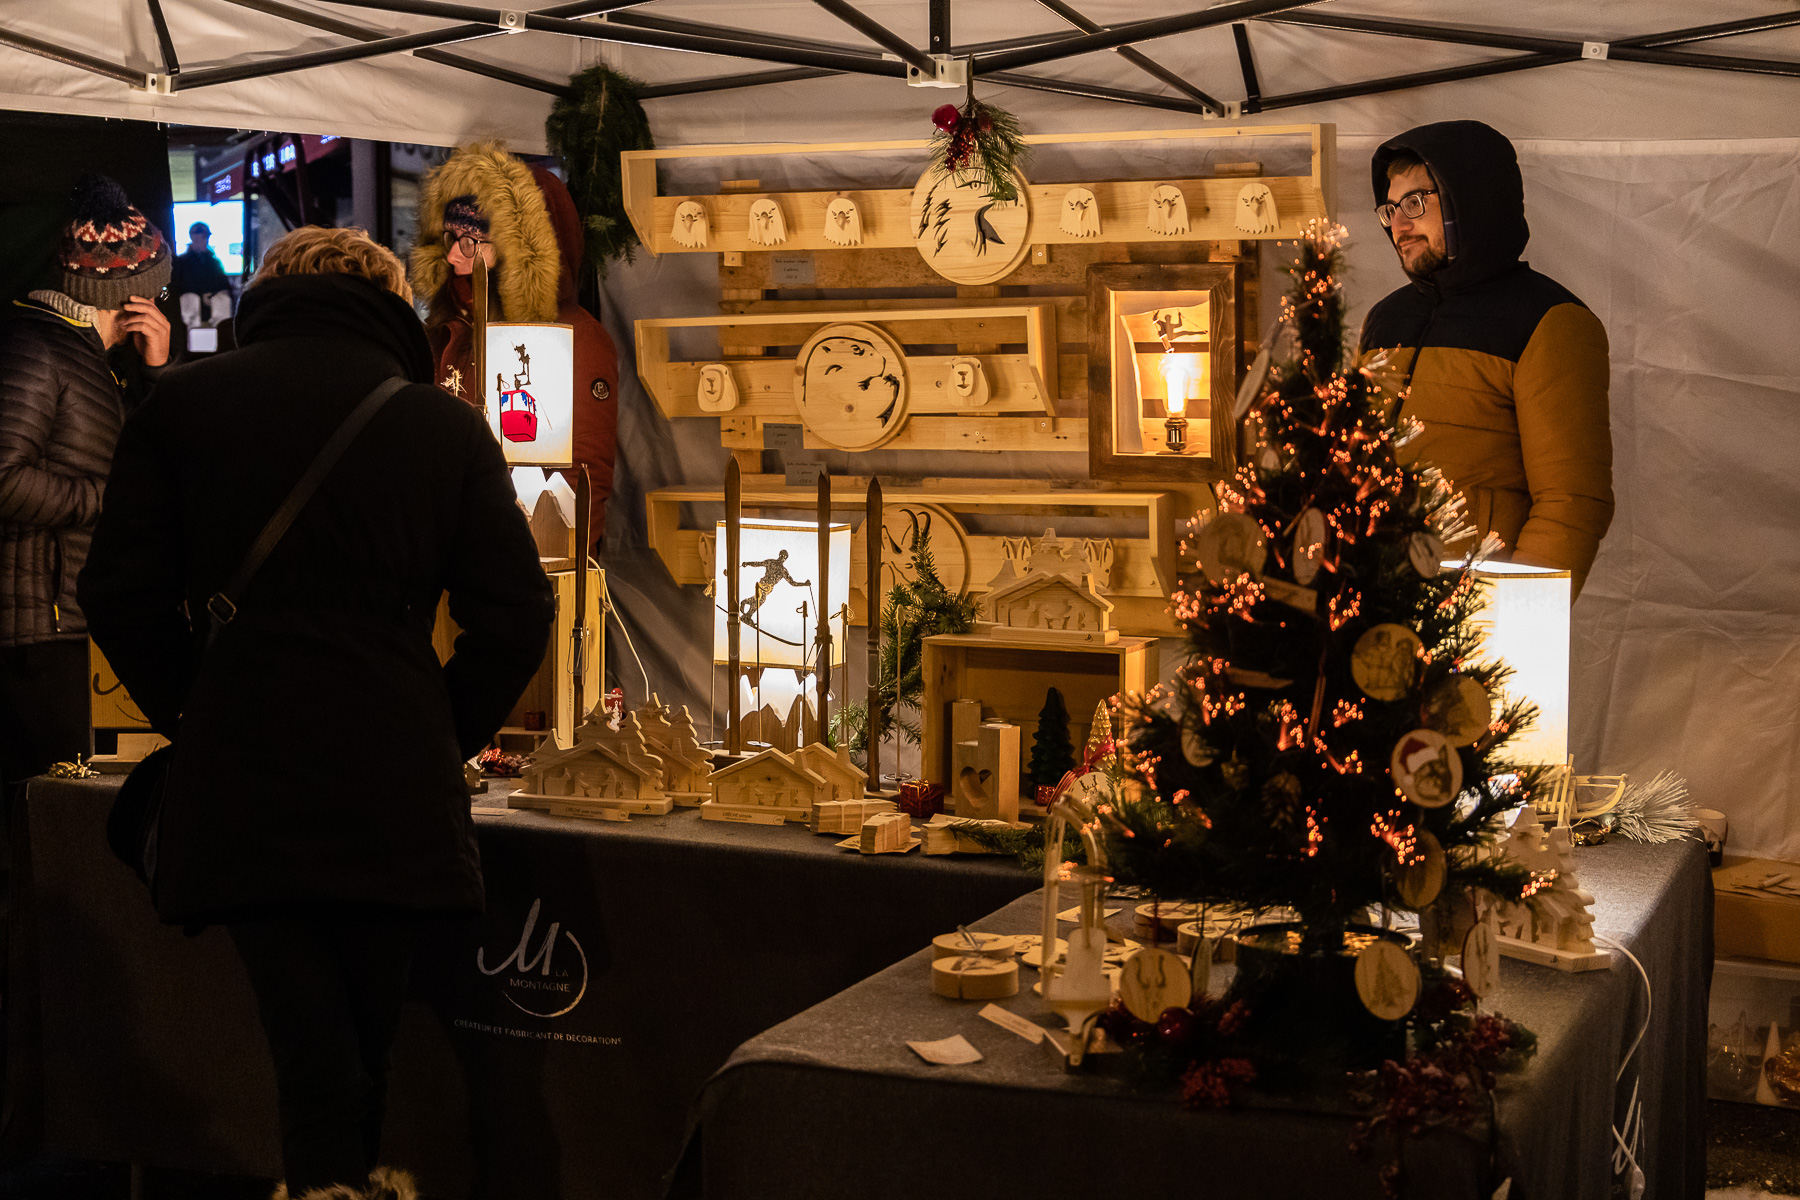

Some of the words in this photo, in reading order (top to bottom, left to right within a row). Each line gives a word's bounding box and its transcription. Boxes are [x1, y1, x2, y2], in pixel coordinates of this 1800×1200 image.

[509, 978, 571, 993] MONTAGNE
[493, 1026, 503, 1035] ET
[504, 1028, 552, 1040] FABRICANT
[553, 1032, 564, 1041] DE
